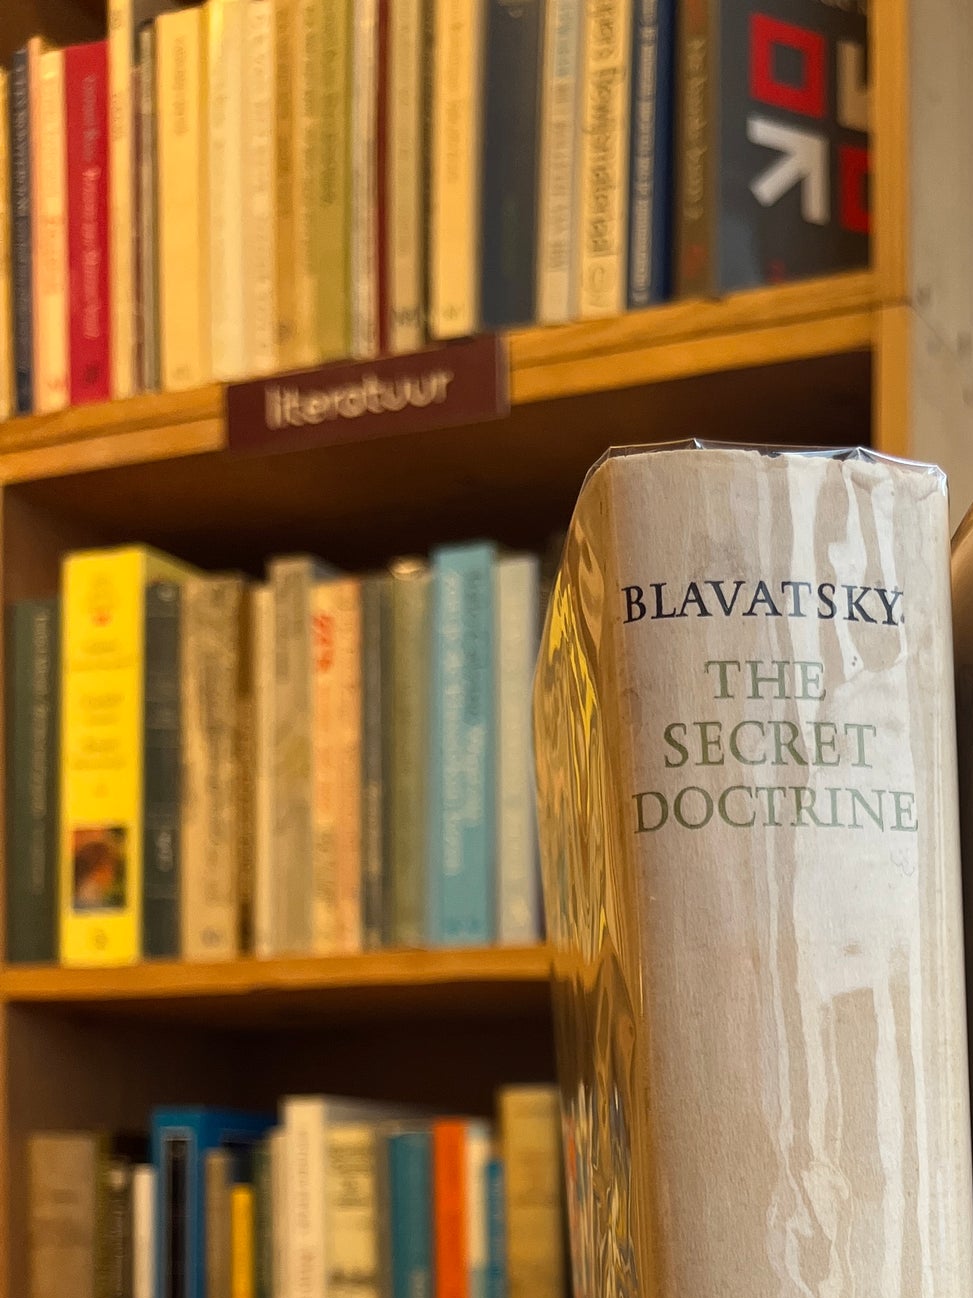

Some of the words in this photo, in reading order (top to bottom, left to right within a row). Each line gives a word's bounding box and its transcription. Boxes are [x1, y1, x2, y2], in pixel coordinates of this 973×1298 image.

[622, 580, 905, 626] BLAVATSKY
[704, 660, 827, 701] THE
[663, 720, 877, 769] SECRET
[631, 785, 919, 834] DOCTRINE
